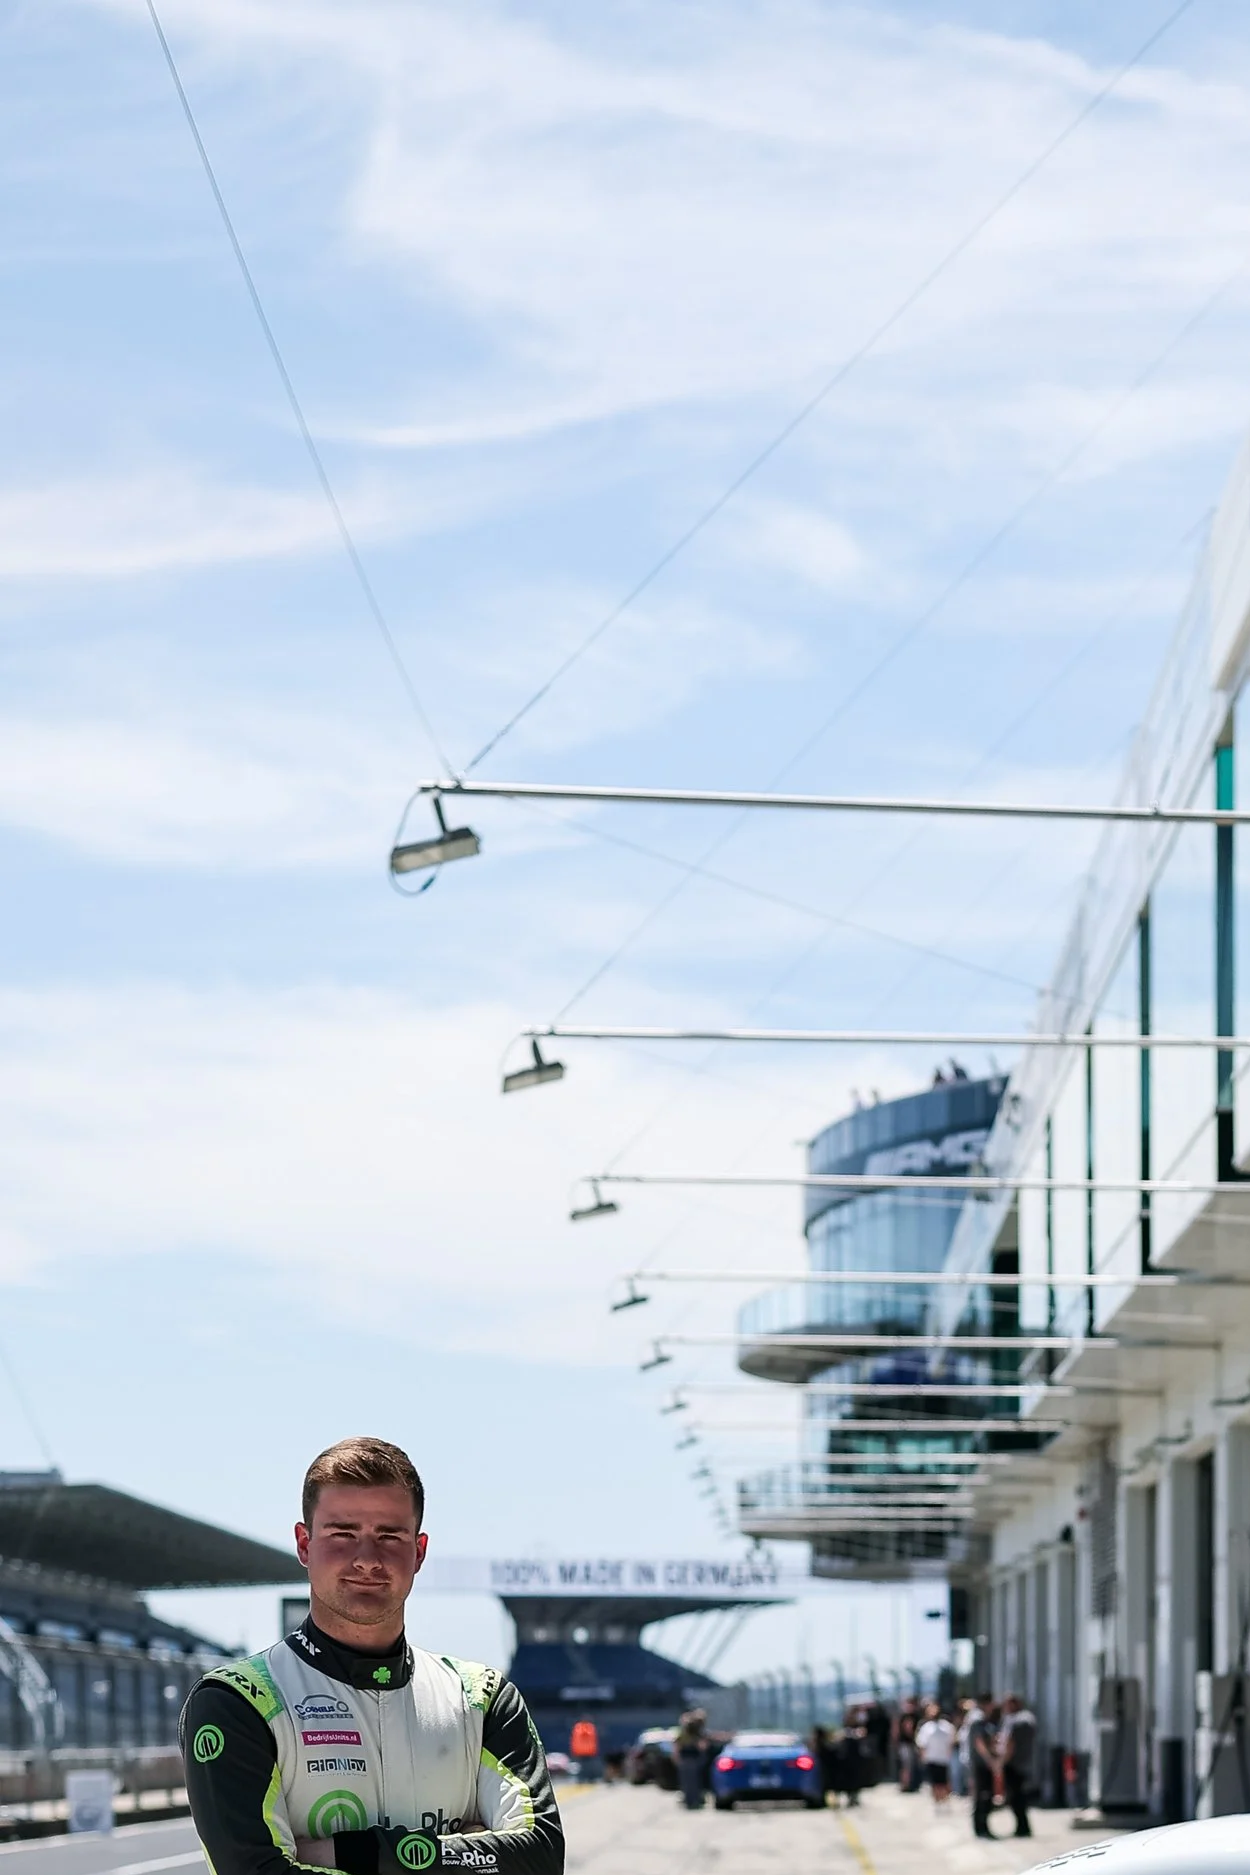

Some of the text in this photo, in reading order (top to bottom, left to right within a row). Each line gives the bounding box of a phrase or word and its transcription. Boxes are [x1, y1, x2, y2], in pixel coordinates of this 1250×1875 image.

[491, 1560, 550, 1586] 100%
[558, 1560, 623, 1585] MADE
[635, 1560, 656, 1585] IN
